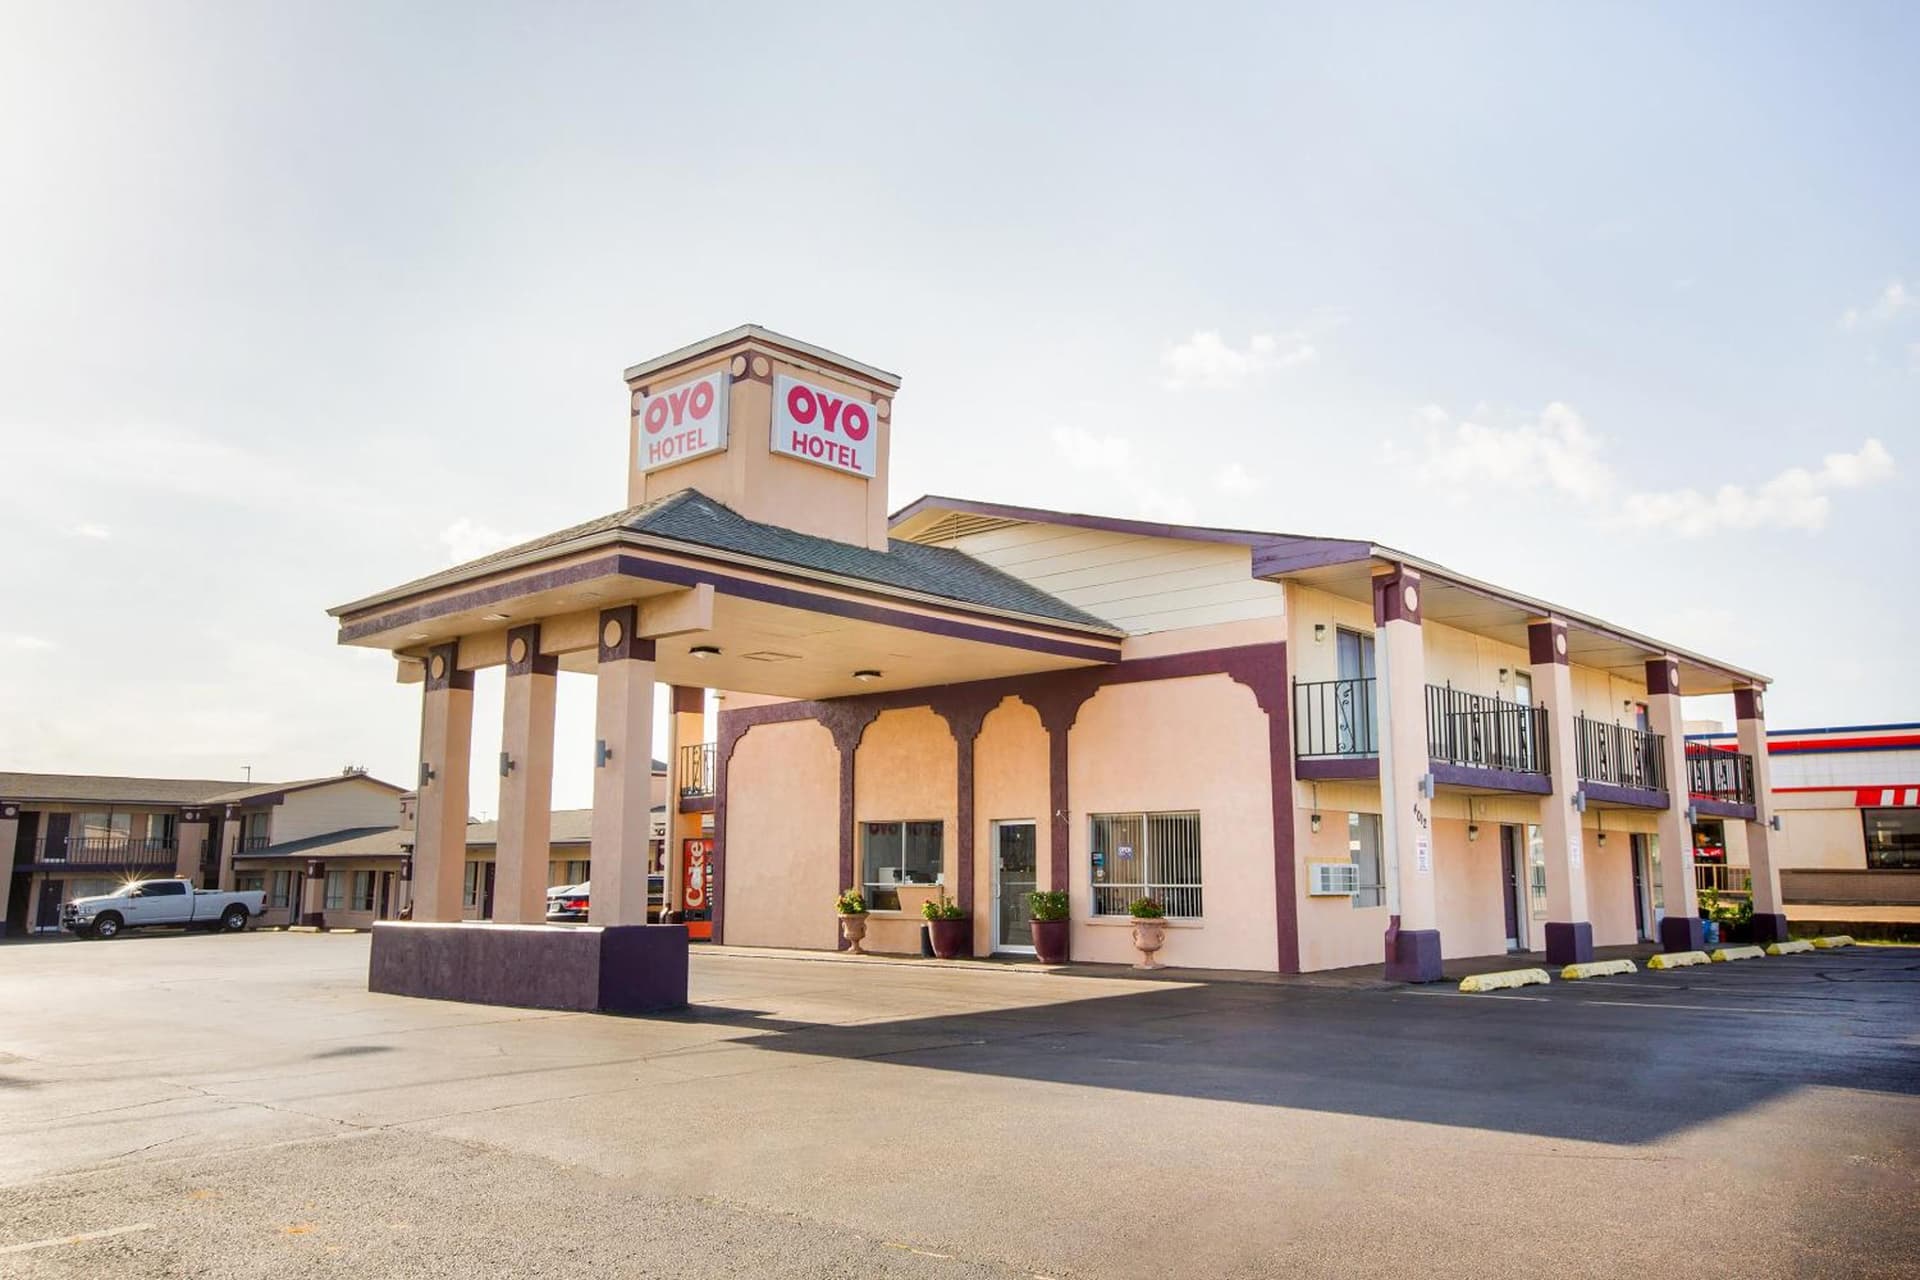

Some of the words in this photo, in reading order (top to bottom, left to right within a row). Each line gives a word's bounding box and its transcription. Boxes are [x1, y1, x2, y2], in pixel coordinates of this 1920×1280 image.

[644, 380, 714, 434] OYO
[787, 384, 870, 441] OYO
[649, 427, 707, 464] HOTEL
[792, 430, 862, 470] HOTEL
[686, 840, 704, 907] Coke
